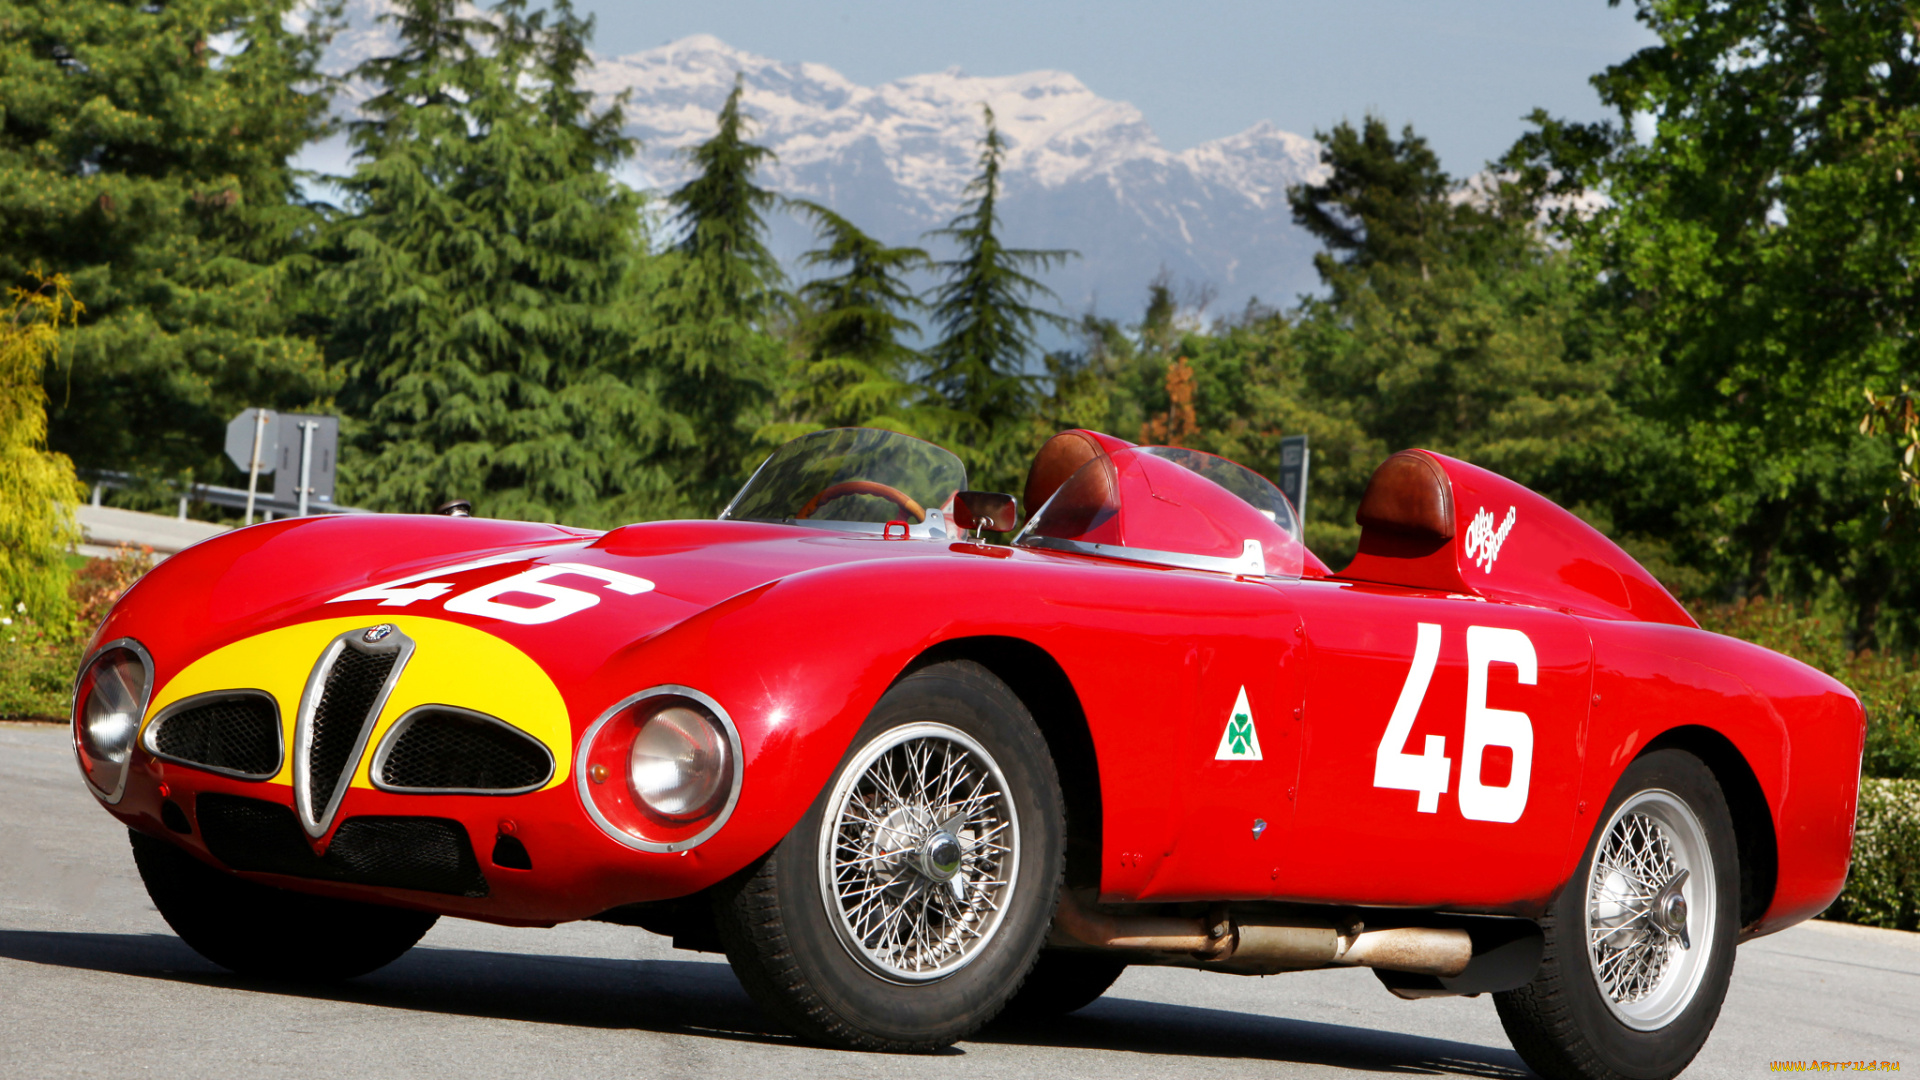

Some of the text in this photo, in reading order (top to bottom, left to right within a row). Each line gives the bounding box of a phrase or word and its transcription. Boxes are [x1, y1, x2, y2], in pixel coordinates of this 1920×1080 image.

[1465, 506, 1494, 568] Alfa
[1483, 505, 1516, 574] Romeo
[324, 540, 656, 625] 46
[1373, 622, 1538, 824] 46
